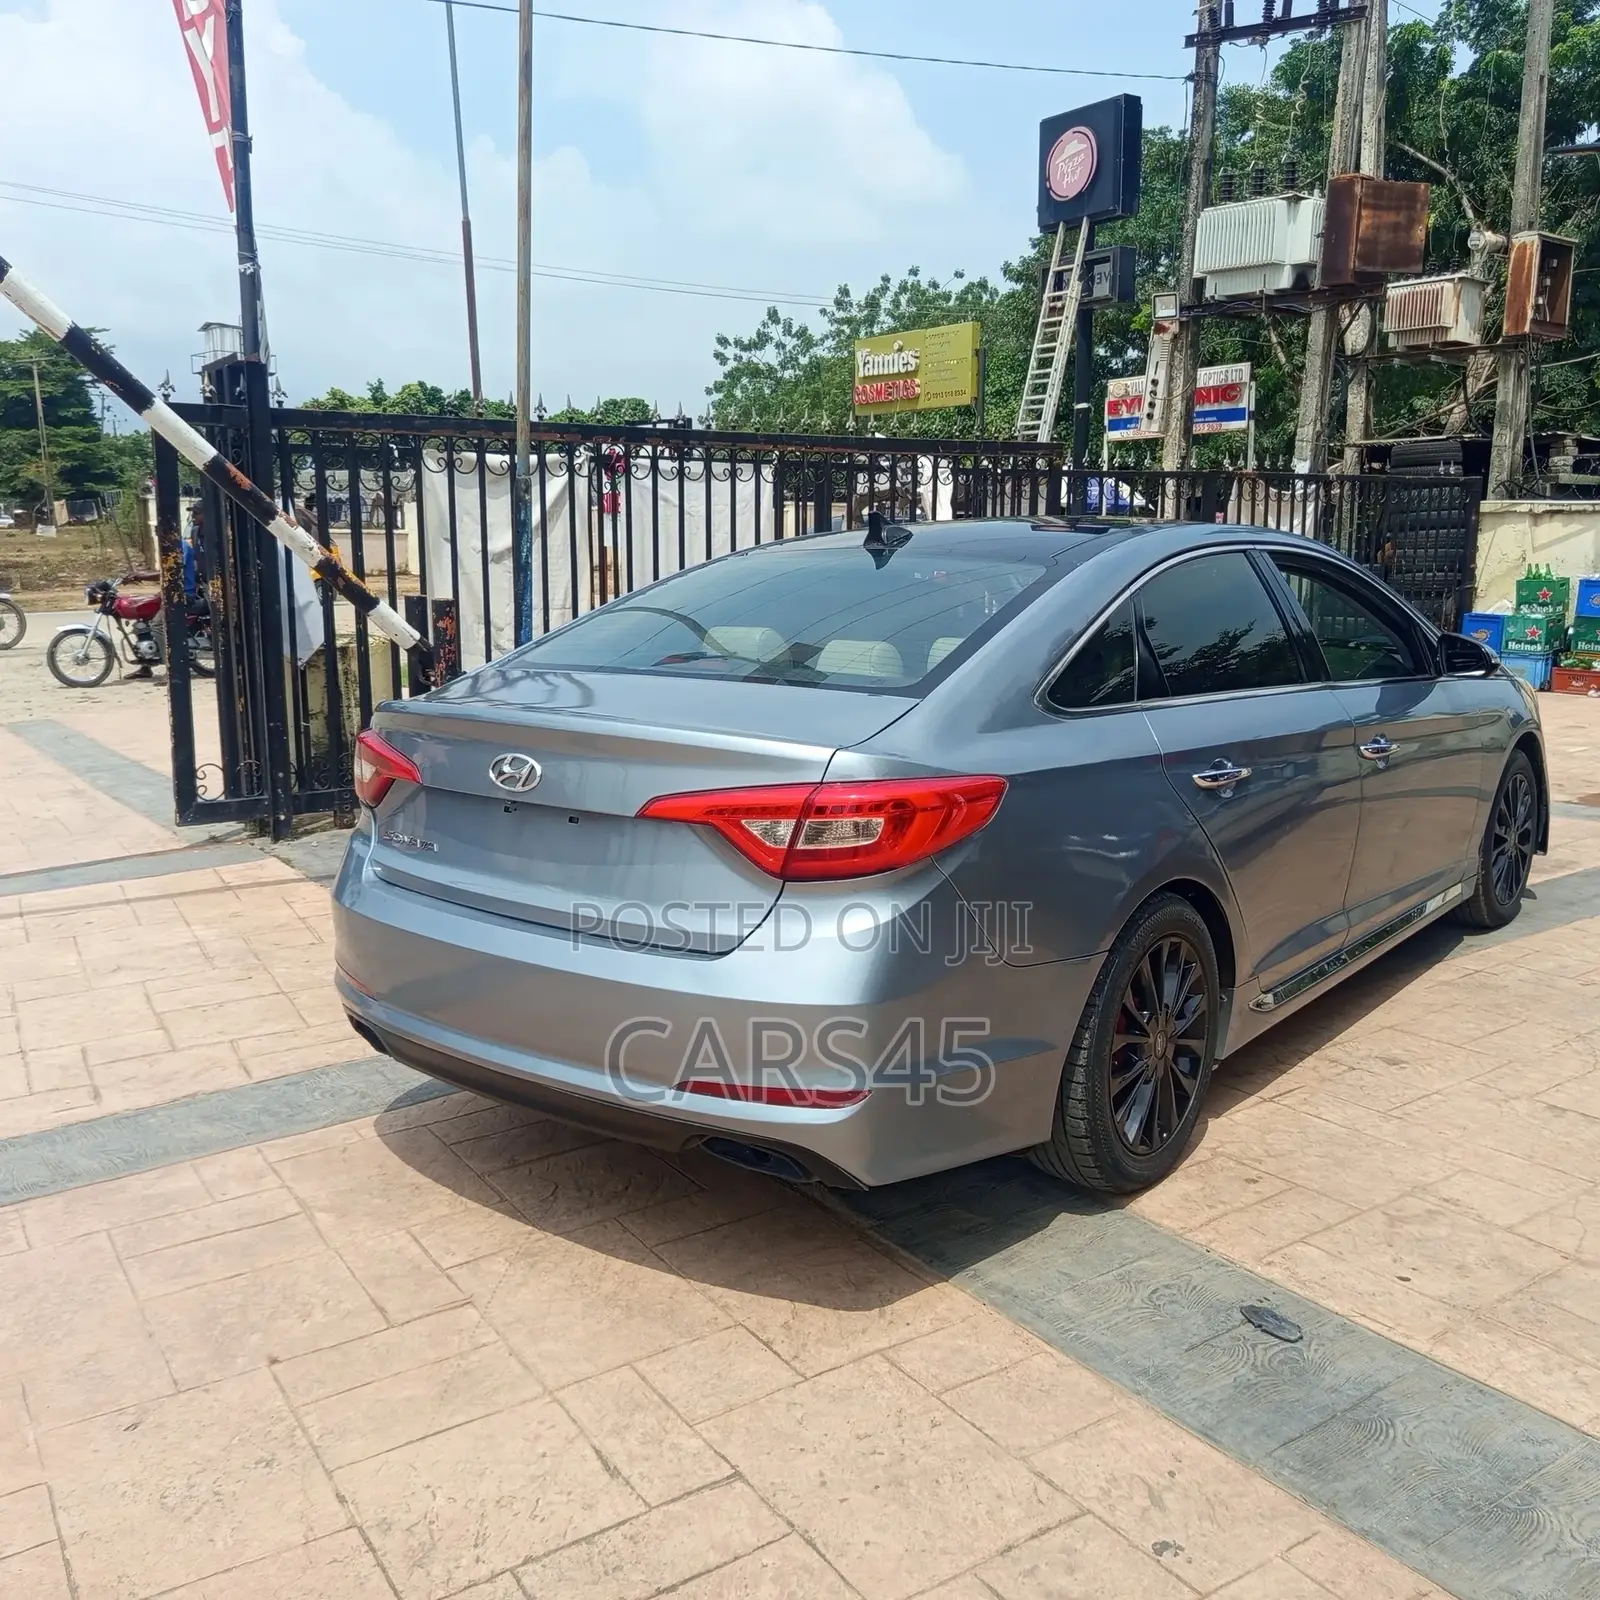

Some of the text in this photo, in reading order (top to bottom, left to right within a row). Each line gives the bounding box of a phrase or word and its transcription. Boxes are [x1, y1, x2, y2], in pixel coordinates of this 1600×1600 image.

[1057, 153, 1086, 180] Pizza
[1062, 166, 1083, 189] Hut
[857, 341, 920, 377] Yannies
[1203, 370, 1229, 385] OPTICS
[1231, 368, 1244, 382] LTD
[854, 379, 920, 405] COSMETICS
[1195, 384, 1242, 405] NIC
[382, 829, 439, 853] SONATA
